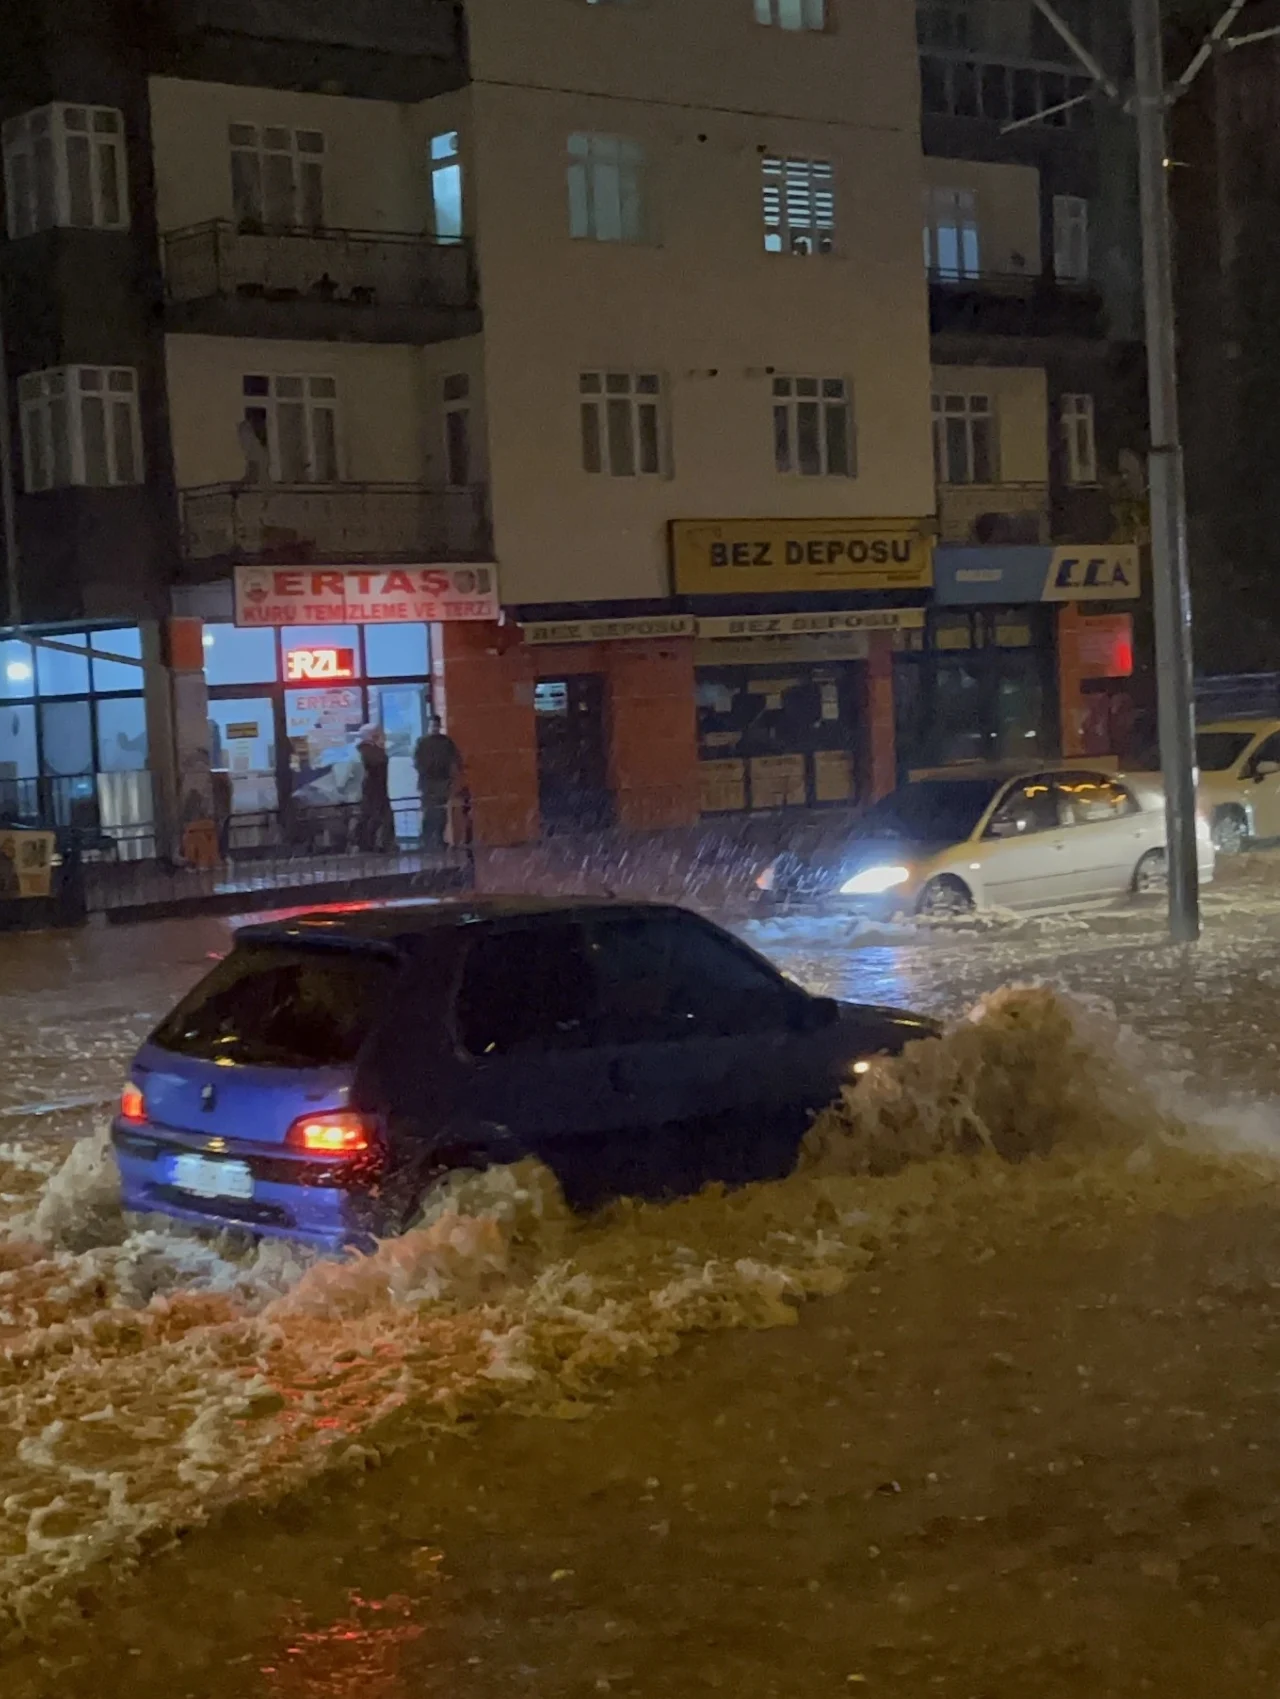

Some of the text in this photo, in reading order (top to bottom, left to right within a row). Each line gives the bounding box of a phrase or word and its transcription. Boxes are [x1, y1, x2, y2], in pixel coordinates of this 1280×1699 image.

[710, 539, 912, 567] BEZ DEPOSU
[273, 568, 450, 599] ERTAŞ
[414, 602, 436, 618] VE
[729, 618, 781, 633] BEZ
